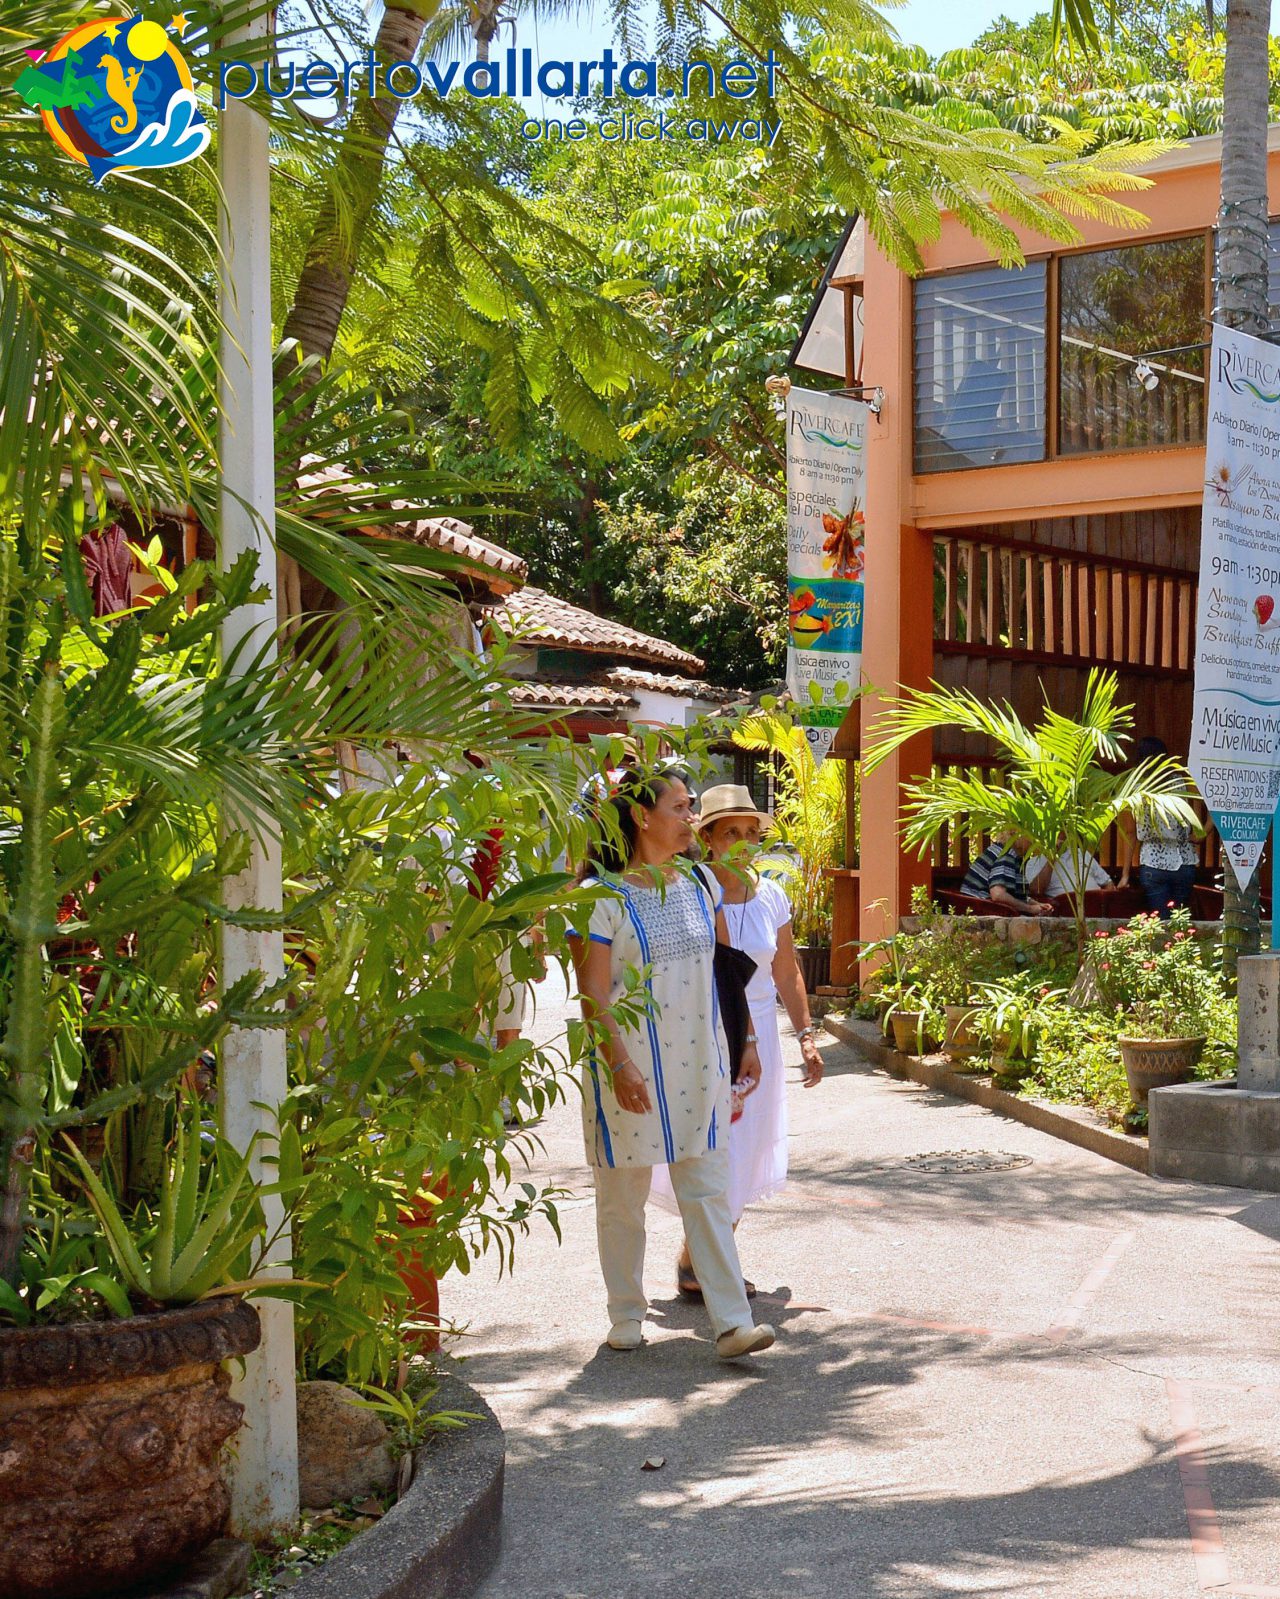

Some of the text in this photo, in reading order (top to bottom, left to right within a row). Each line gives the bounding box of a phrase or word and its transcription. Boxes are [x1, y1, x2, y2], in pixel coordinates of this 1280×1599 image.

[1239, 419, 1259, 436] Diario
[1262, 427, 1280, 442] Open
[800, 468, 805, 476] 8
[807, 470, 818, 478] am
[841, 477, 854, 485] pm
[834, 463, 851, 475] Open
[1247, 485, 1257, 497] los
[1218, 532, 1223, 540] a
[1260, 542, 1268, 552] de
[1211, 556, 1239, 576] 9am
[1206, 587, 1232, 604] Now
[818, 658, 829, 669] en
[829, 658, 850, 670] vivo
[1201, 653, 1233, 667] Delicious
[812, 668, 838, 681] Music
[1202, 707, 1247, 730] Música
[1247, 716, 1261, 732] en
[1213, 729, 1273, 754] Live Music
[1201, 766, 1269, 784] RESERVATIONS:
[1204, 781, 1229, 799] (322)
[1220, 815, 1266, 830] RIVERCAFE
